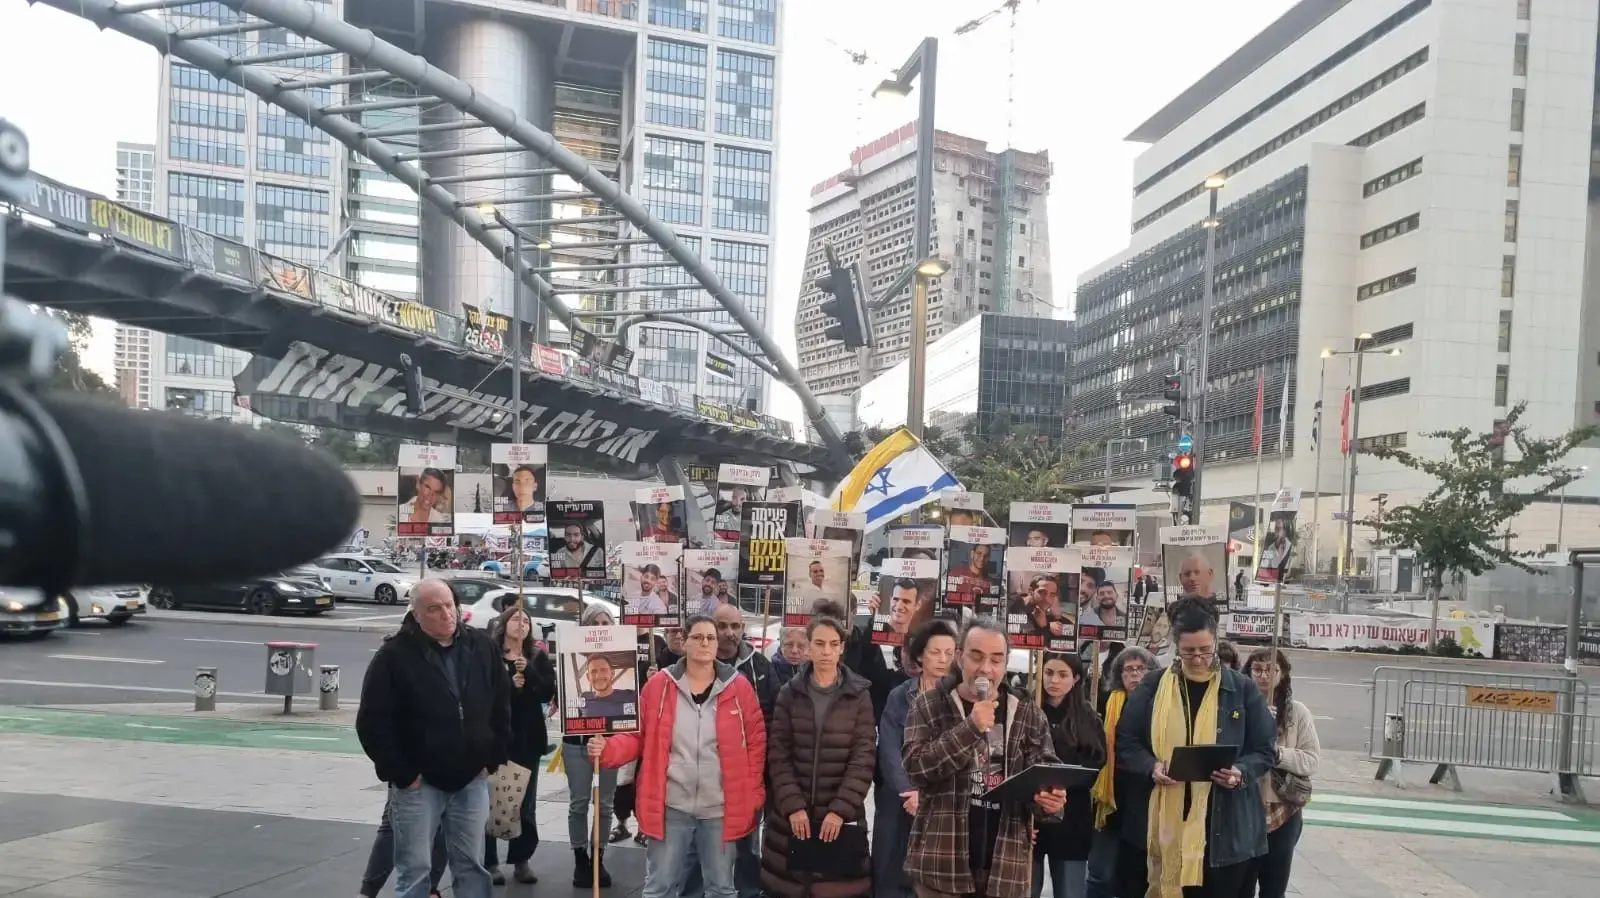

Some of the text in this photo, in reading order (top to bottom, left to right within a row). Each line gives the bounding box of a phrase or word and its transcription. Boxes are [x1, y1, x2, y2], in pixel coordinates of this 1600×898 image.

[564, 503, 580, 513] עדיין
[580, 503, 594, 513] מתן
[752, 507, 788, 521] פעימה
[751, 521, 787, 540] אחת
[750, 540, 785, 556] וכולם
[749, 555, 785, 571] בבית!
[1008, 613, 1028, 624] BRING
[1309, 623, 1332, 637] בבית
[1335, 622, 1349, 638] לא
[1352, 624, 1380, 640] עדיין
[1382, 626, 1417, 643] שאתם
